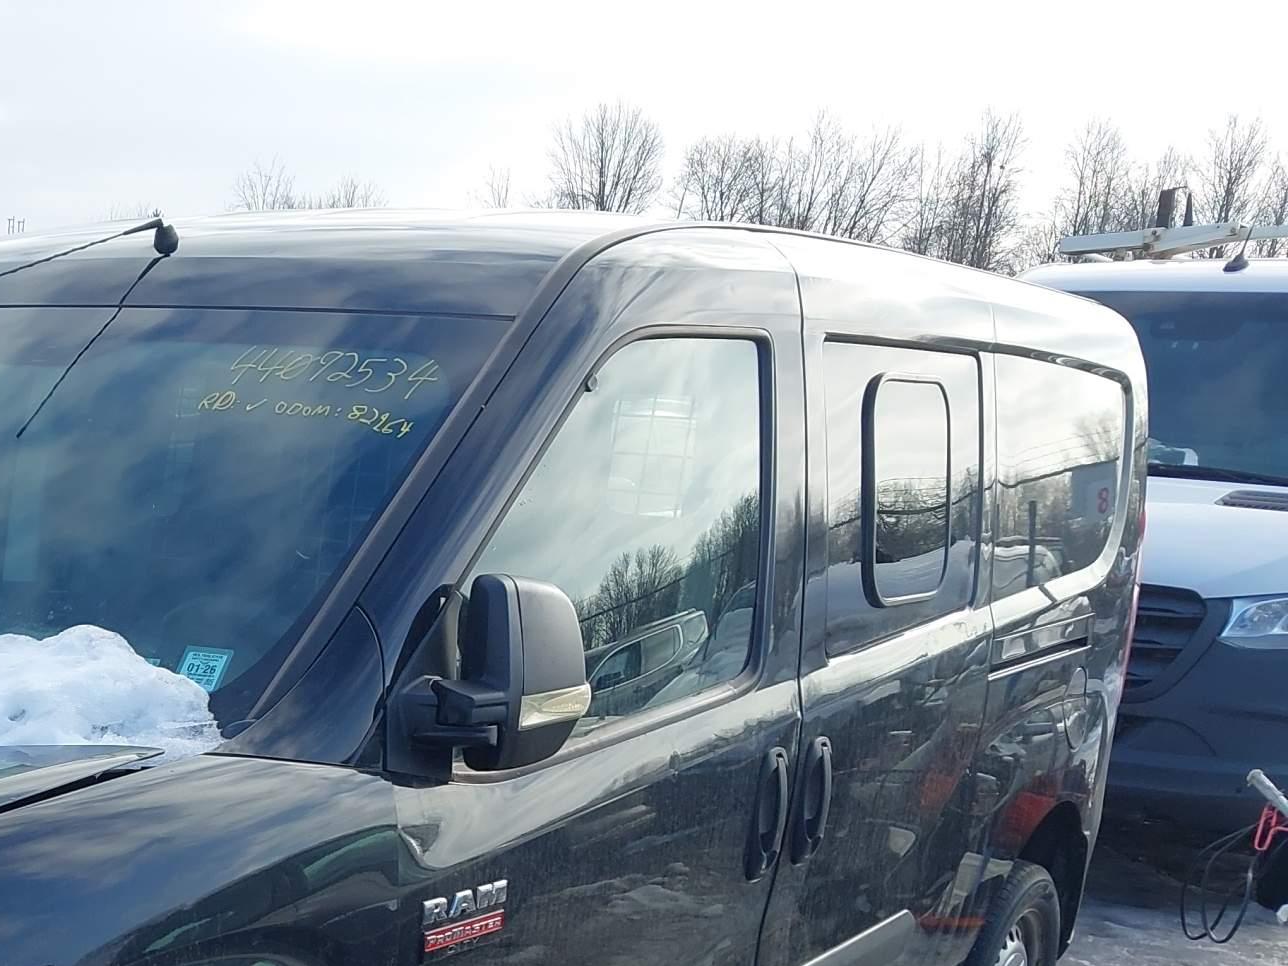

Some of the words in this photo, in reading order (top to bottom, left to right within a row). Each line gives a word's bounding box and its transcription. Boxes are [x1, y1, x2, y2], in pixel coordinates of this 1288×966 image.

[230, 345, 440, 400] 44092534
[186, 662, 218, 675] 01-26
[422, 879, 508, 925] RAM
[425, 916, 503, 948] PROMASTER
